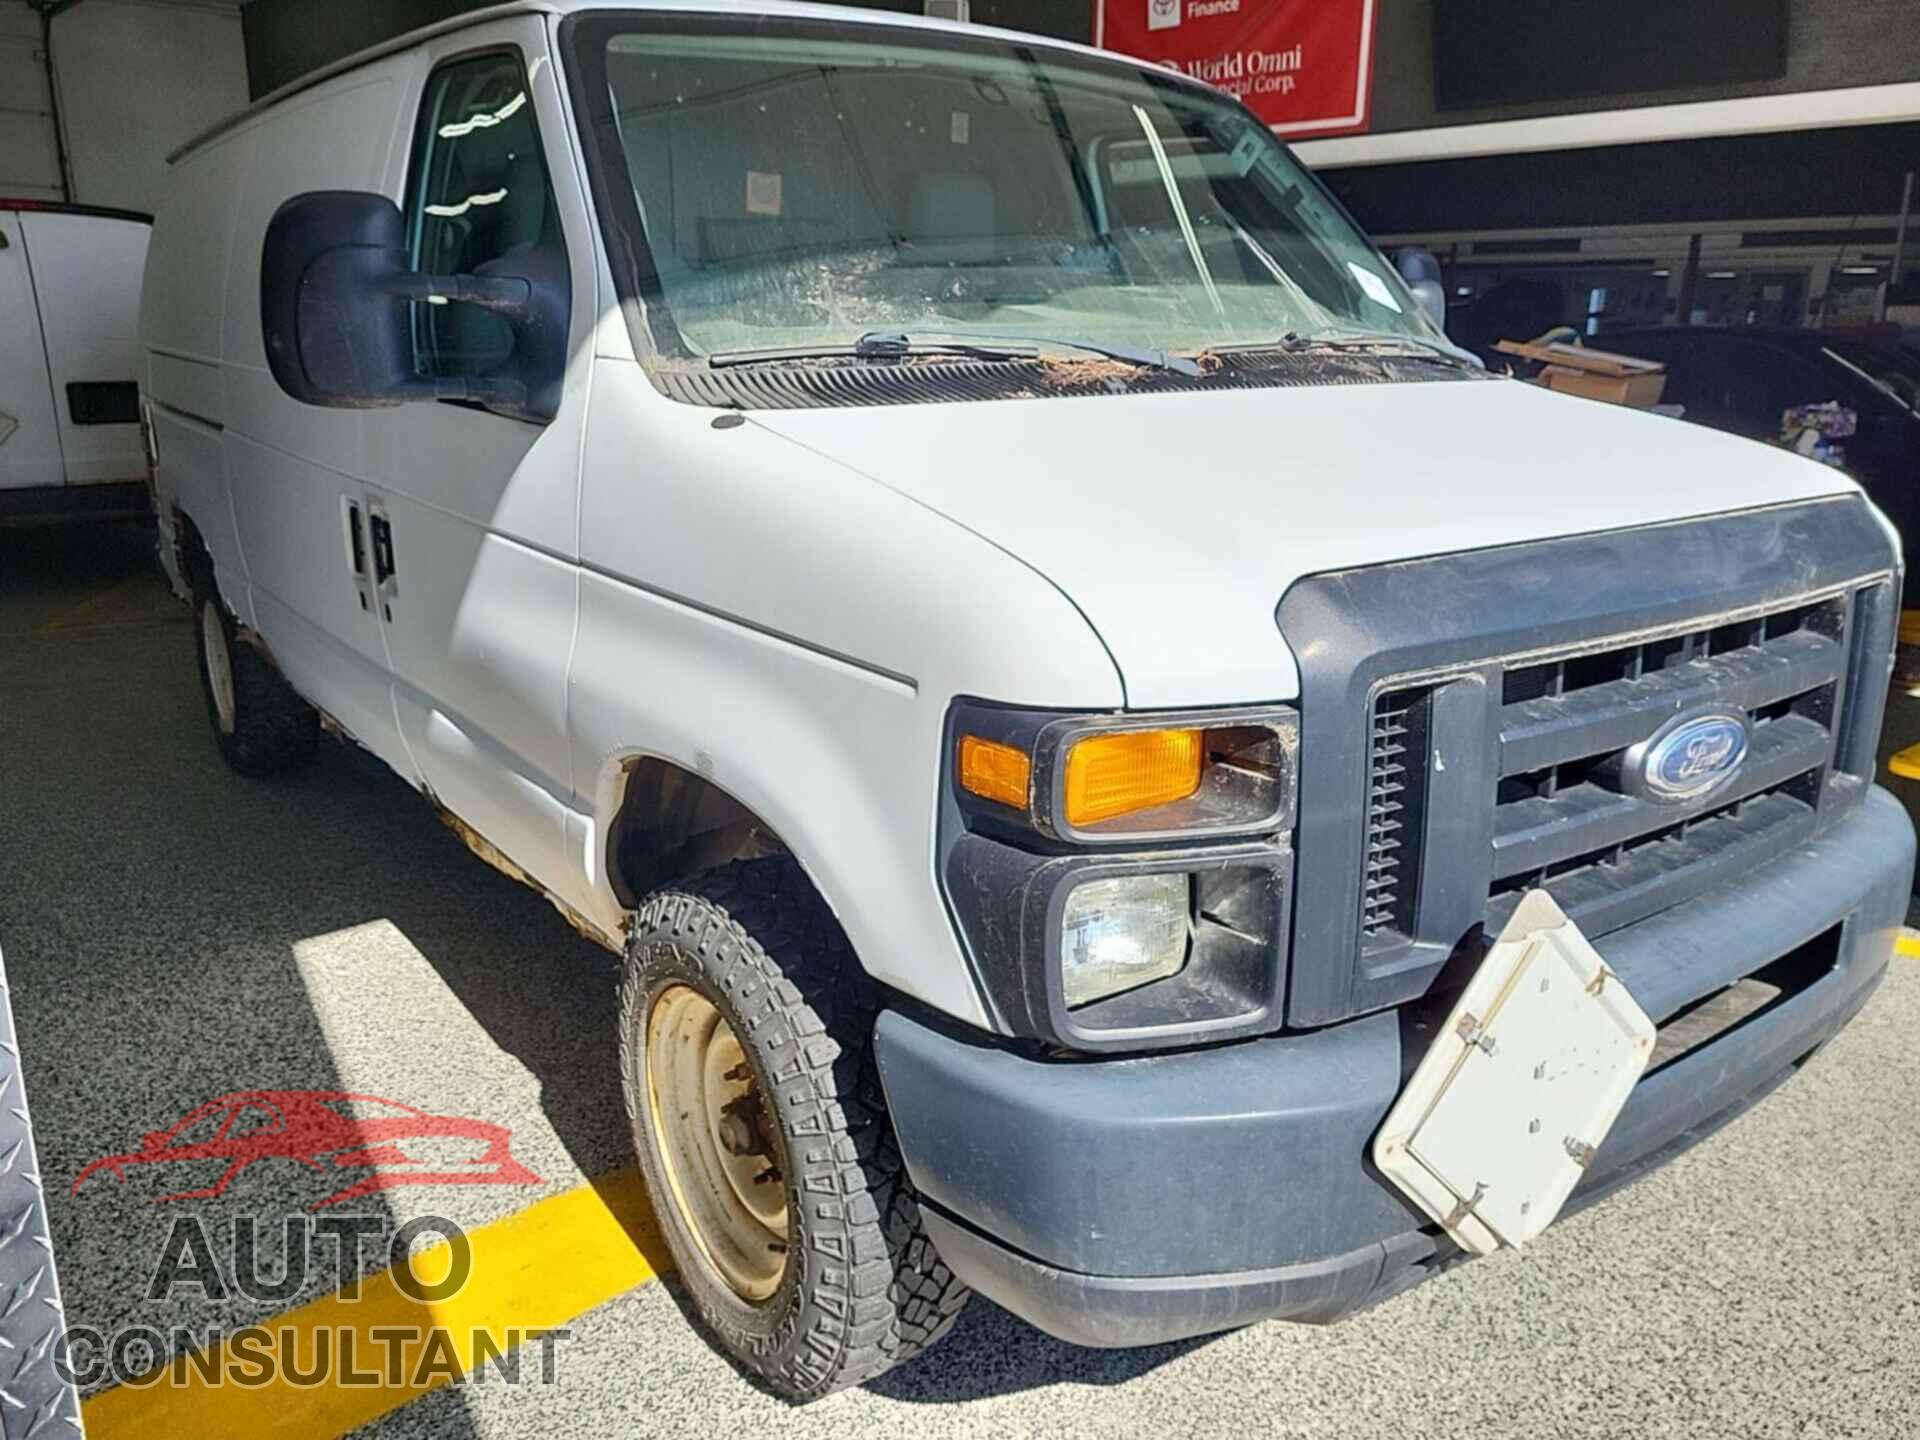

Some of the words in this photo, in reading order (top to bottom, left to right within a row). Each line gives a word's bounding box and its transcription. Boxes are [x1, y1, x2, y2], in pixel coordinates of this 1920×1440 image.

[1187, 0, 1240, 19] Finance
[1188, 51, 1243, 80] World
[1247, 43, 1302, 75] Omni
[1216, 78, 1252, 97] ncial
[1255, 74, 1296, 95] Corp.
[1679, 732, 1734, 779] Ford
